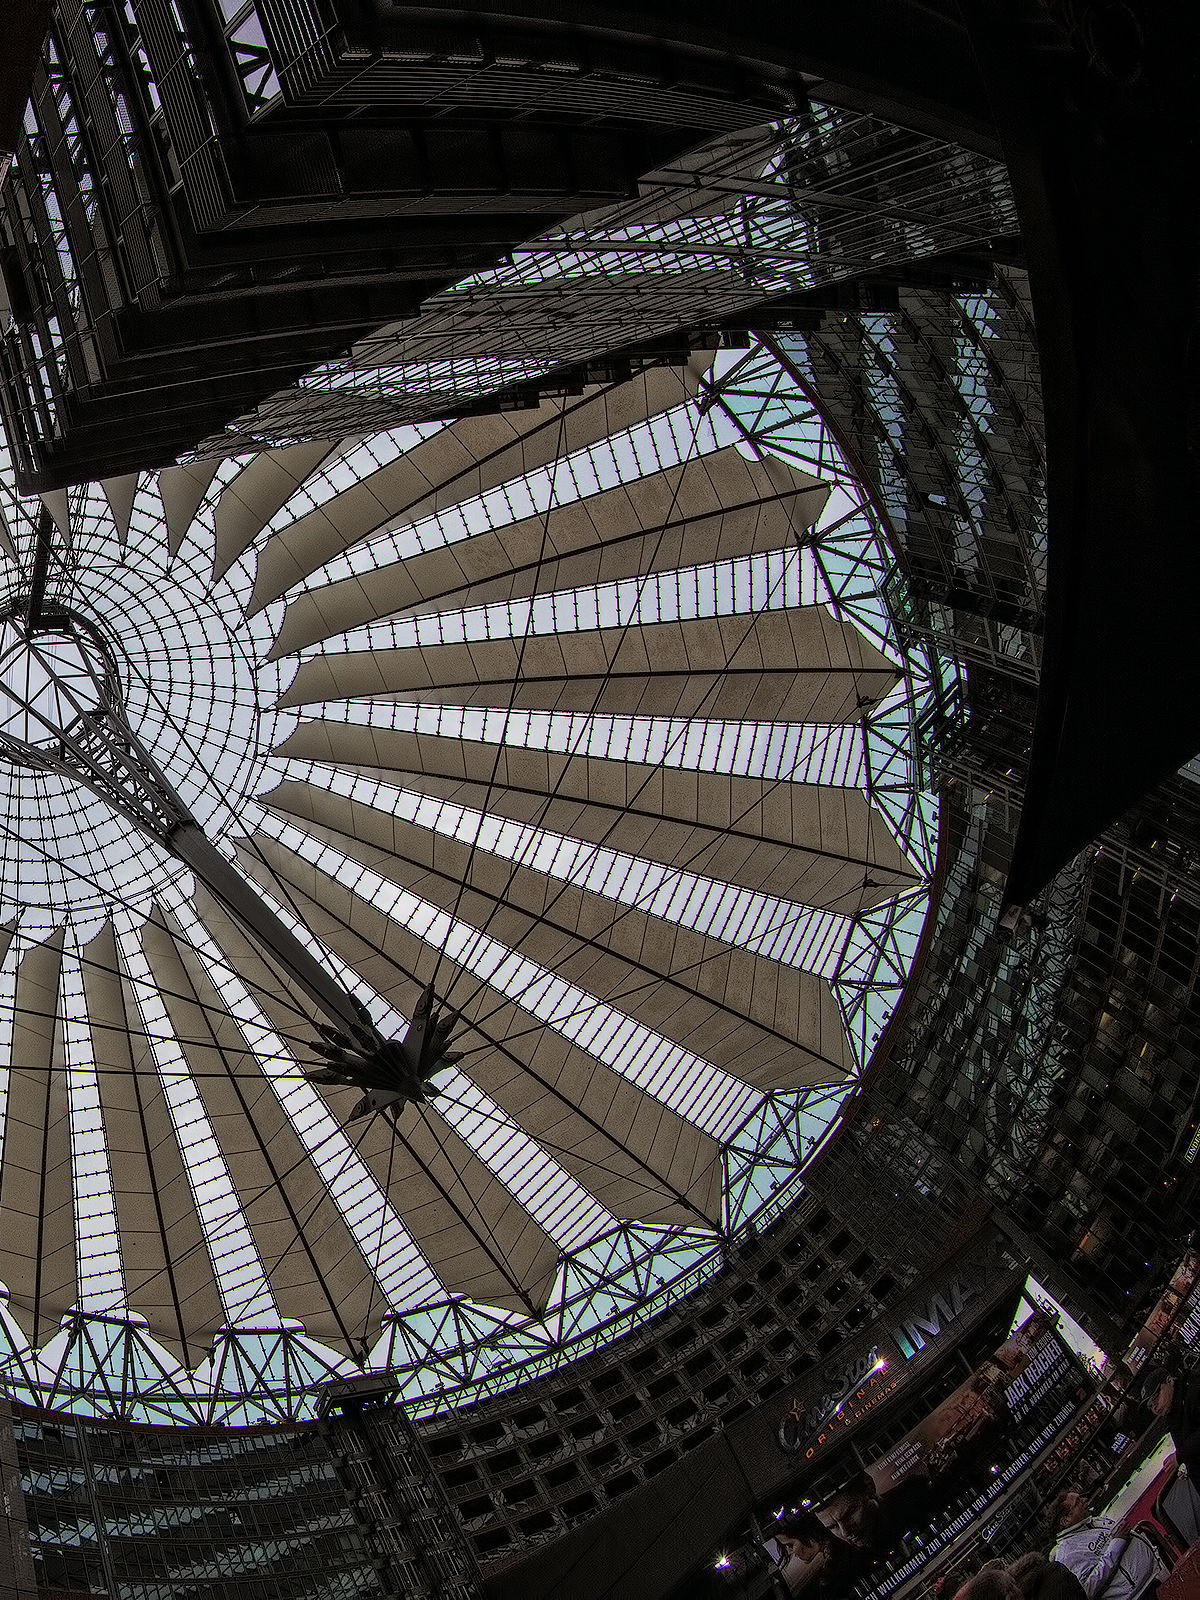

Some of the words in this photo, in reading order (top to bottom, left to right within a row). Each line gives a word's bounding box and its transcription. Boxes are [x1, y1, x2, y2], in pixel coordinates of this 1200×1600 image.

[806, 1368, 888, 1458] ORIGINAL
[1003, 1373, 1030, 1409] JACK
[1024, 1339, 1062, 1386] REACHER
[1029, 1378, 1054, 1407] NOVEMBER
[877, 1550, 927, 1596] WILLKOMMEN
[925, 1537, 942, 1555] ZUR
[940, 1507, 974, 1542] PREMIERE
[971, 1494, 988, 1512] VON
[986, 1478, 1004, 1499] JACK
[1001, 1452, 1032, 1483] REACHER:
[1028, 1436, 1045, 1454] KEIN
[1040, 1423, 1056, 1440] WEG
[1053, 1400, 1076, 1427] ZURÜCK
